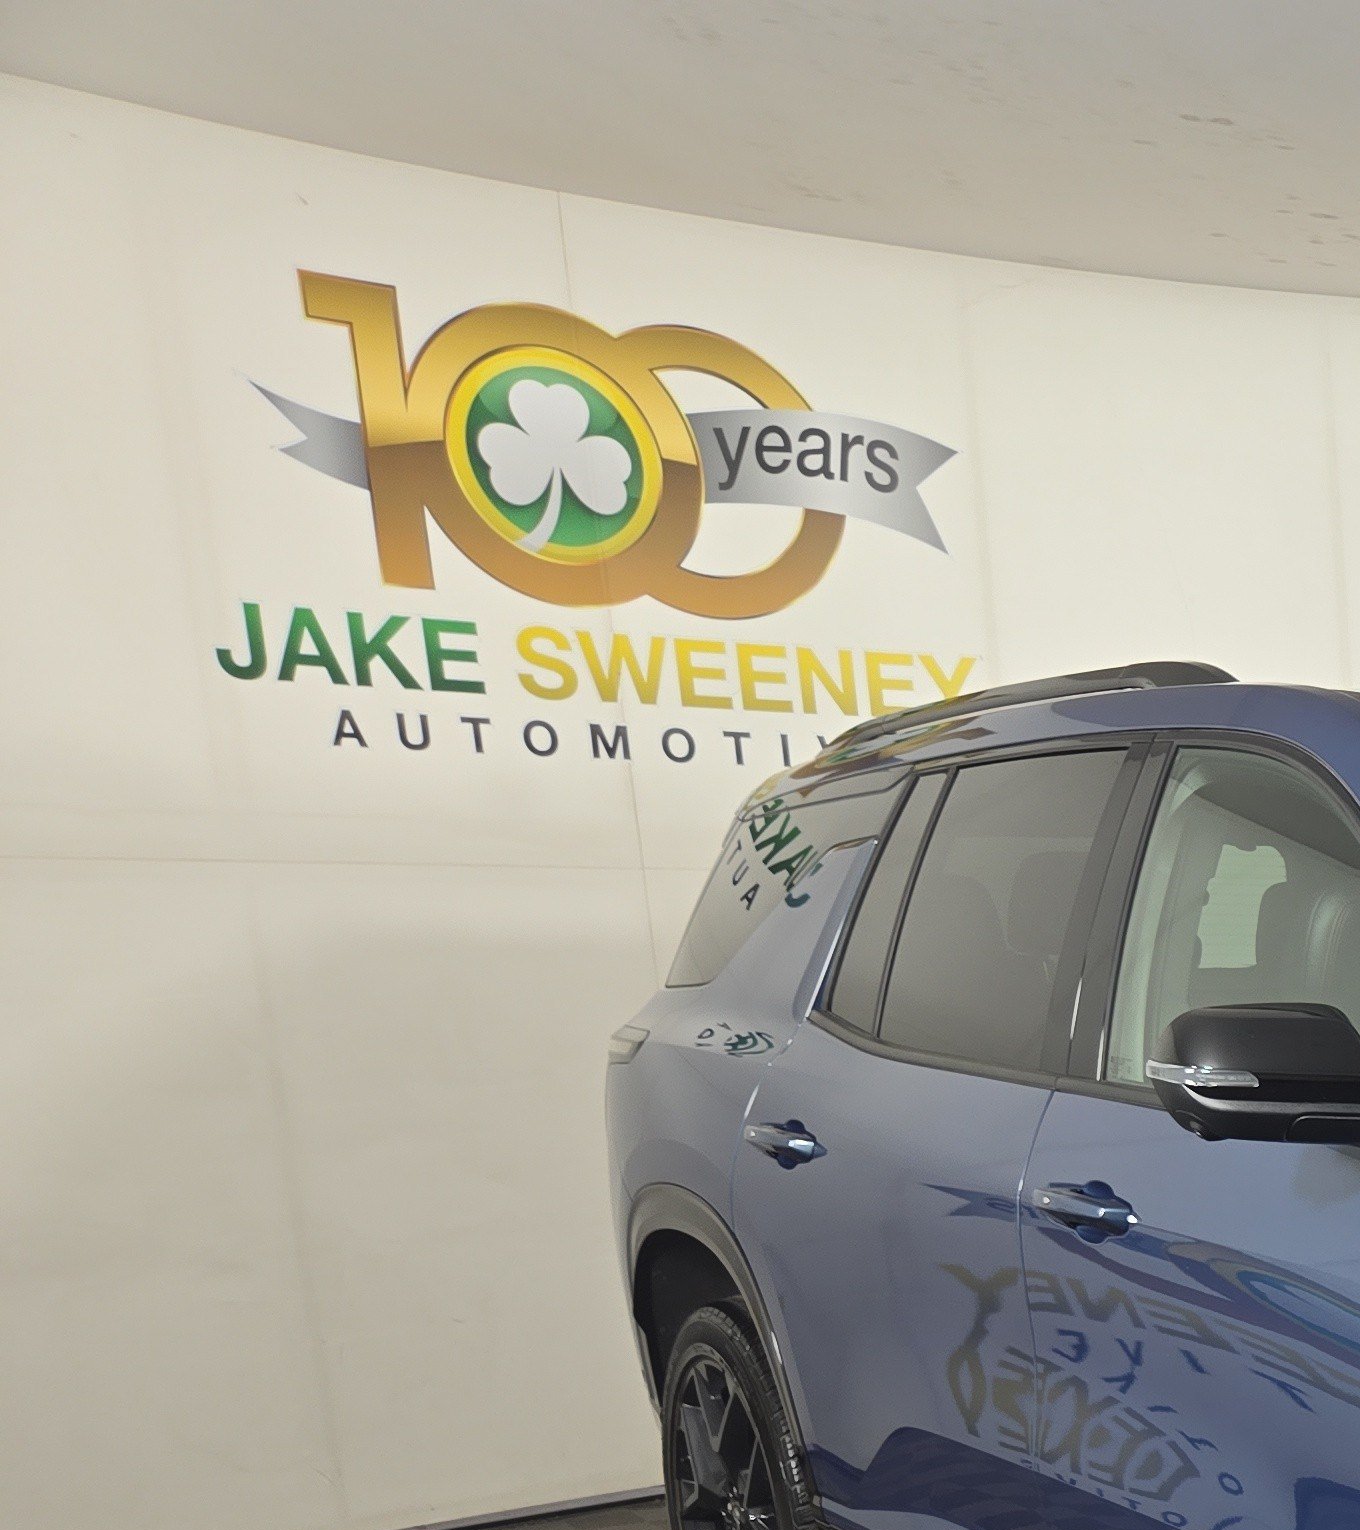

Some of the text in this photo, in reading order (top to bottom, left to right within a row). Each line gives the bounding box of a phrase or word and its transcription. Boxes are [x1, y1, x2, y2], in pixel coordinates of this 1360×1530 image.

[712, 424, 901, 493] years
[215, 602, 977, 716] JAKE SWEENEY
